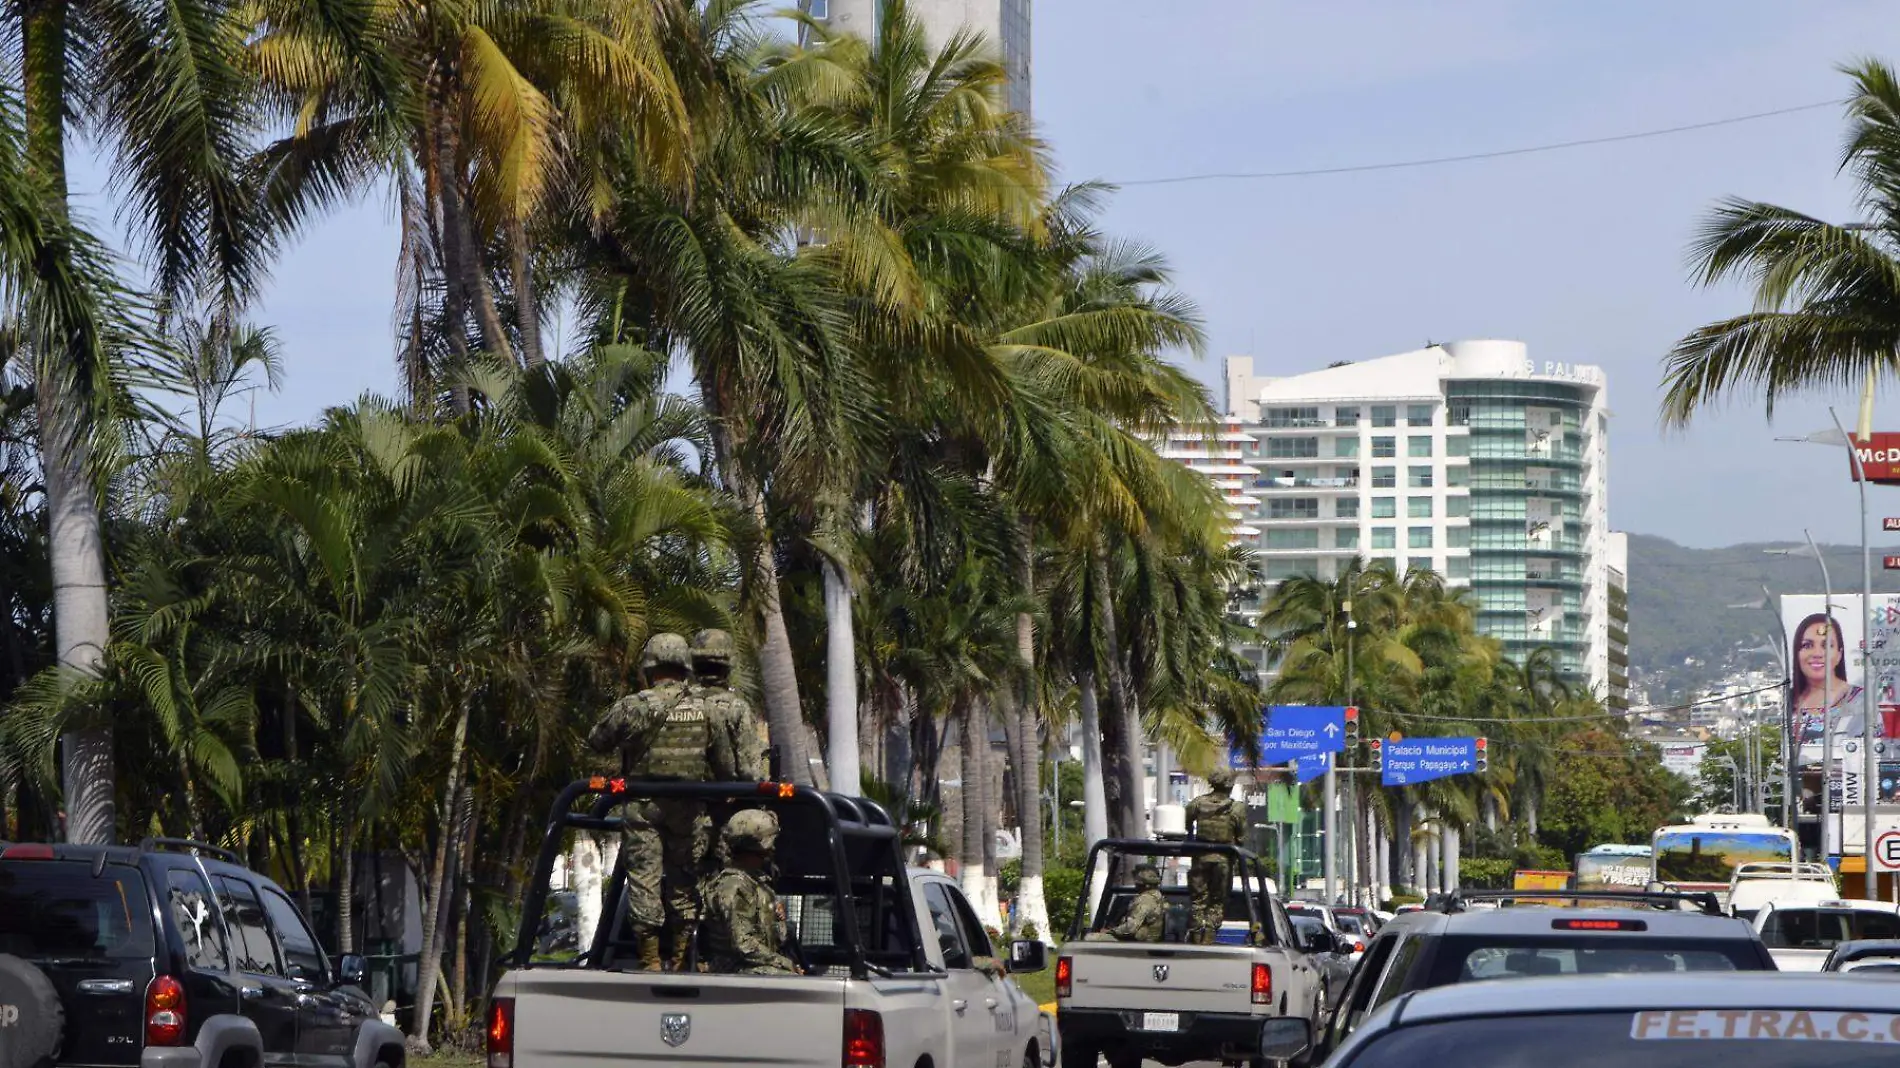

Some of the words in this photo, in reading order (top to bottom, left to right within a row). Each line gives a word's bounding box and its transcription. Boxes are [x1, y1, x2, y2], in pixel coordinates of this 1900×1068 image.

[665, 710, 704, 721] ARINA
[1267, 728, 1285, 737] San
[1288, 728, 1315, 739] Diego
[1388, 745, 1422, 756] Palacio
[1426, 745, 1468, 757] Municipal
[1388, 760, 1416, 771] Parque
[1420, 760, 1458, 772] Papagayo
[1887, 839, 1900, 860] E
[0, 1004, 19, 1028] p
